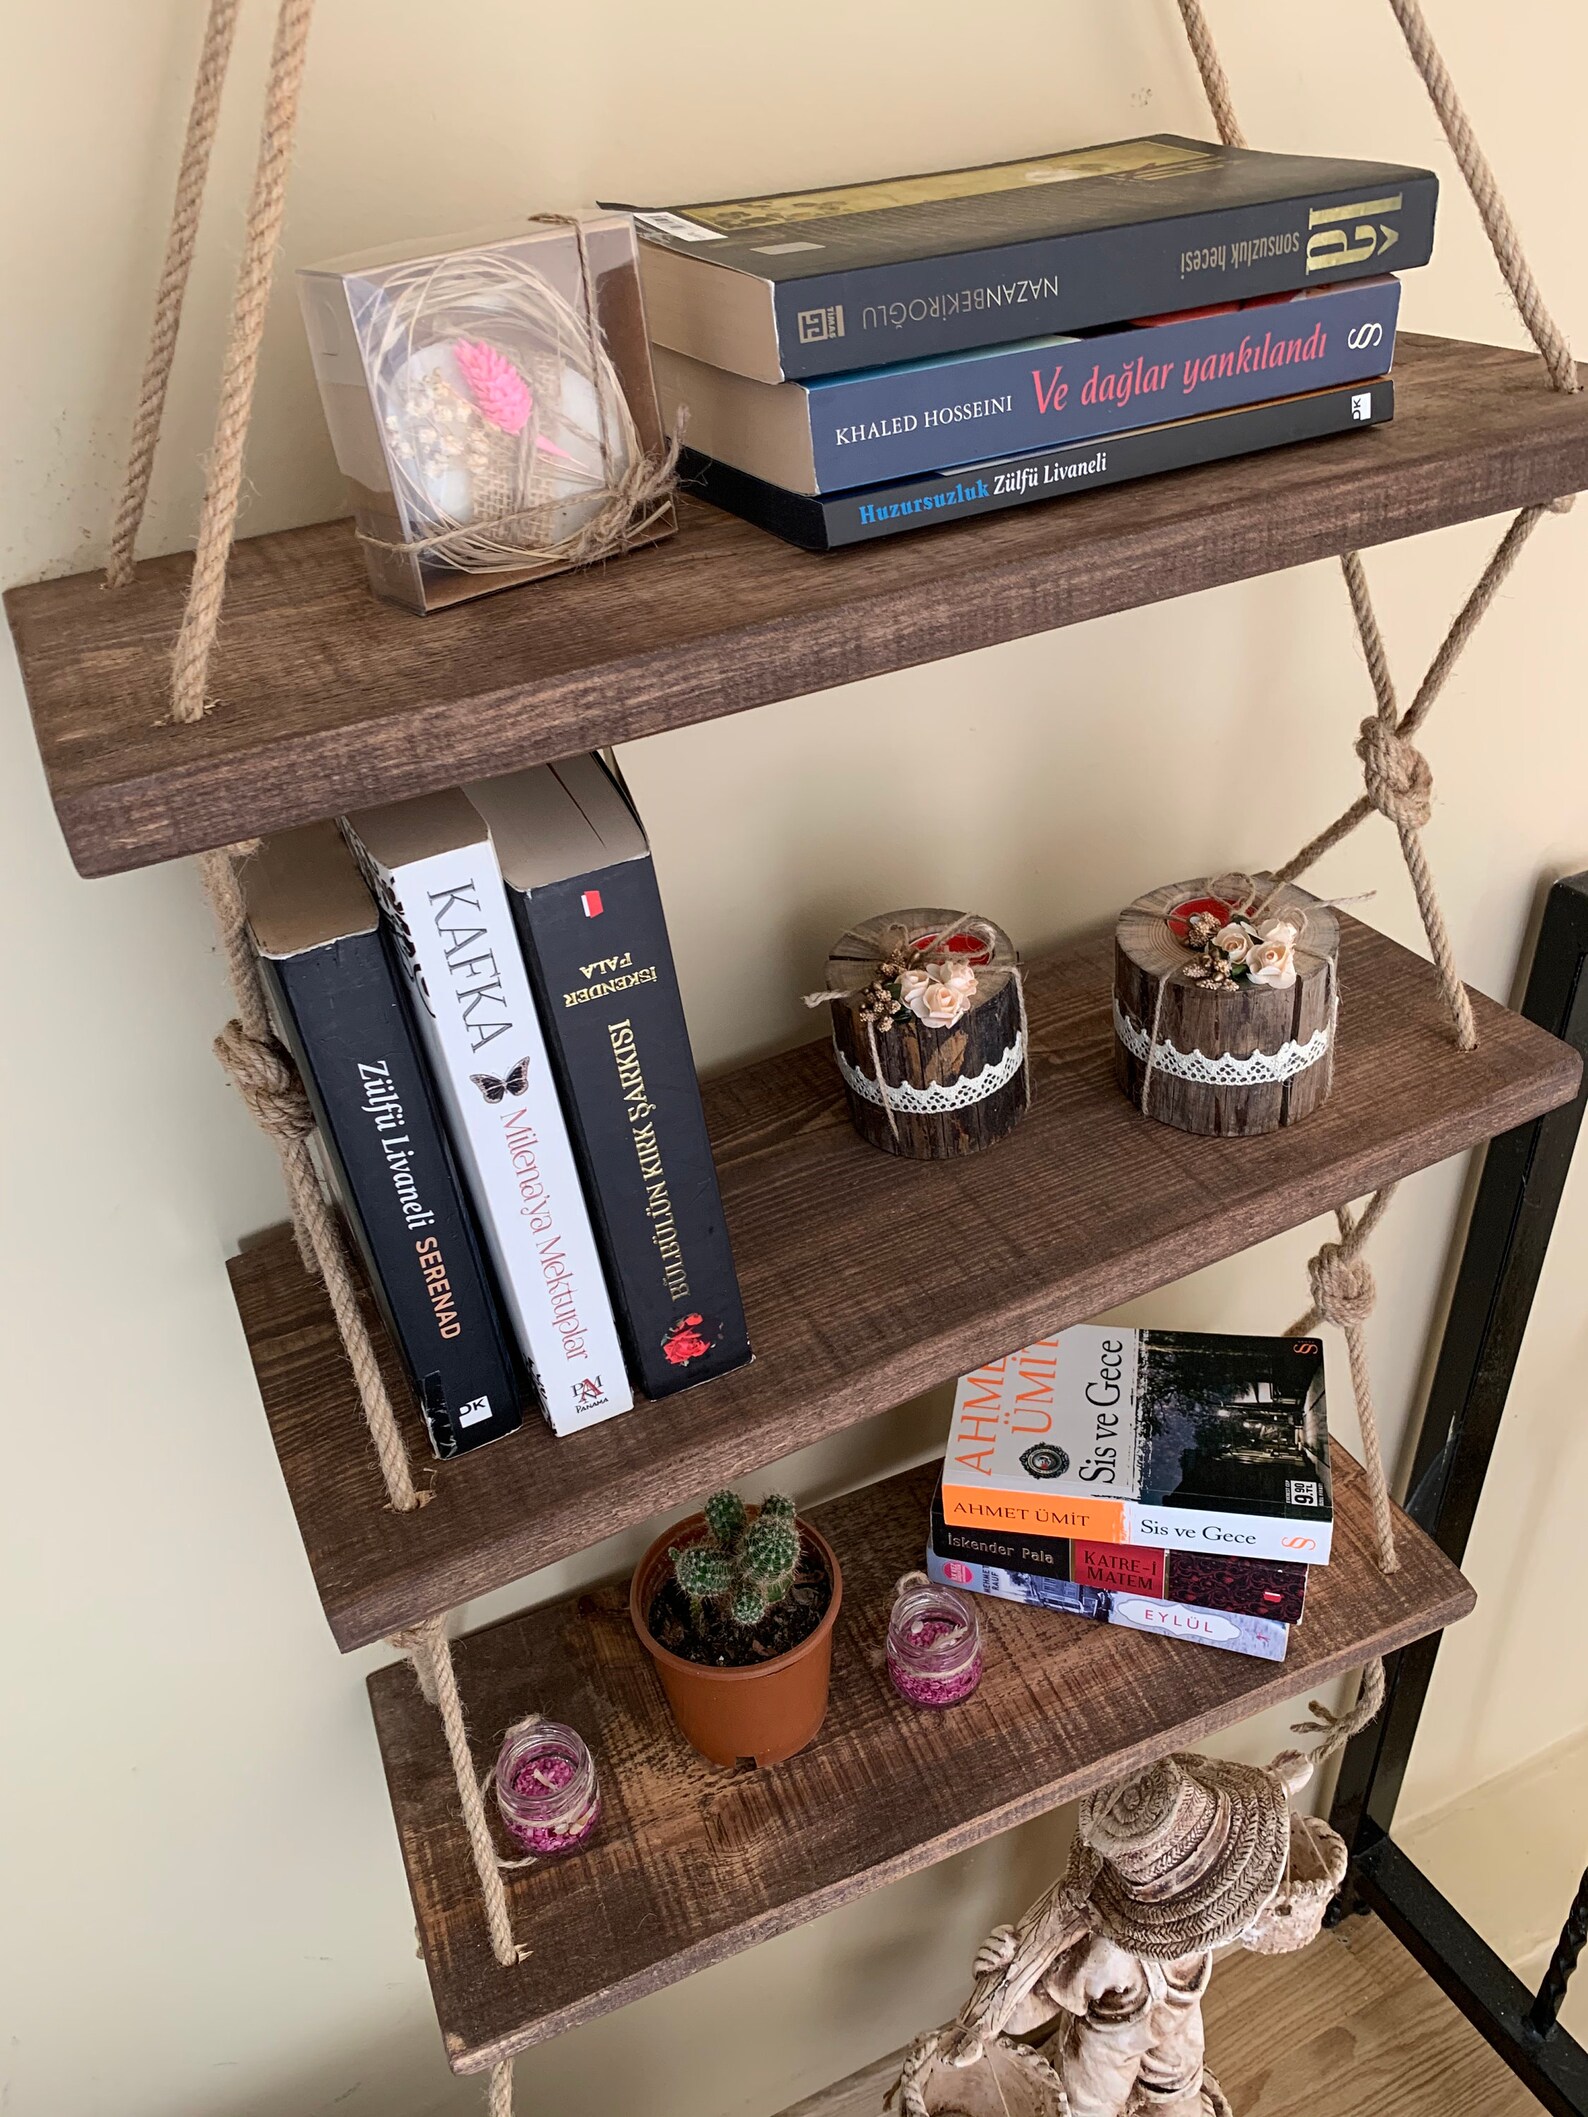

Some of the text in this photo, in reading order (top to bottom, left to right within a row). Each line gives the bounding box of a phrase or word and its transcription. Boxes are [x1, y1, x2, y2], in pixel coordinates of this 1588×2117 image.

[1180, 232, 1300, 279] sonsuzluk hecesi
[1031, 321, 1328, 415] Ve dağlar yankılandı
[835, 395, 1013, 446] KHALED HOSSEINI
[858, 452, 1107, 525] Huzursuzluk Zülfü Livaneli
[426, 878, 513, 1053] KAFKA
[563, 966, 658, 1008] İSKENDER
[579, 952, 633, 979] PALA
[357, 1060, 436, 1231] Zülfü Livaneli
[608, 1018, 691, 1301] BÜLBÜLÜN KIRK ŞARKISI
[500, 1107, 589, 1361] Milena'ya Mektuplar
[415, 1236, 462, 1340] SERENAD
[1079, 1340, 1123, 1484] Sis ve Gece
[954, 1502, 1090, 1526] AHMET ÜMİT
[1140, 1519, 1257, 1545] Sis ve Gece
[1022, 1547, 1054, 1564] Pala
[1087, 1566, 1153, 1590] MATEM
[991, 1571, 1000, 1591] RAUF
[1145, 1609, 1214, 1634] EYLÜL
